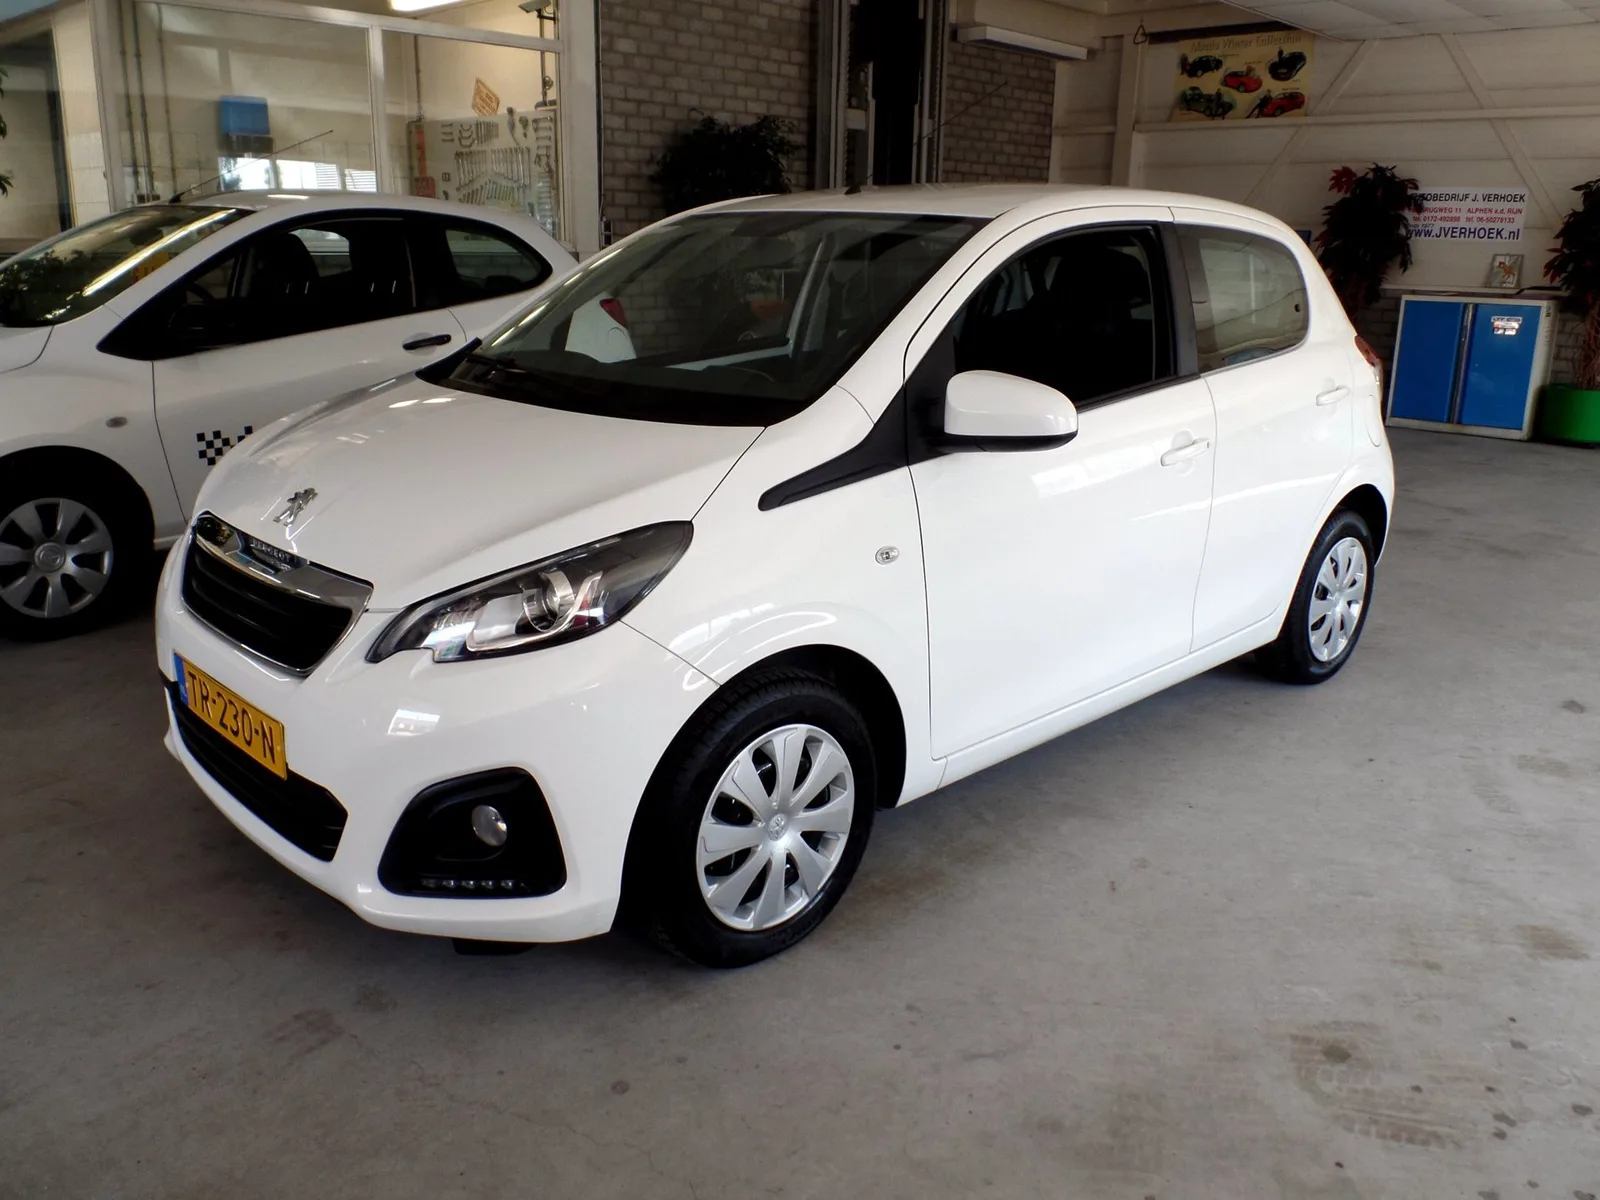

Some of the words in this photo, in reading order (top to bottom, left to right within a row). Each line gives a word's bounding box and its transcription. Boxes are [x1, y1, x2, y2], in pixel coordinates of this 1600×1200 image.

[1222, 38, 1252, 49] Winter
[1255, 34, 1302, 47] Collection
[1471, 193, 1479, 202] J.
[1482, 193, 1526, 203] VERHOEK
[188, 670, 276, 765] TR-230-N
